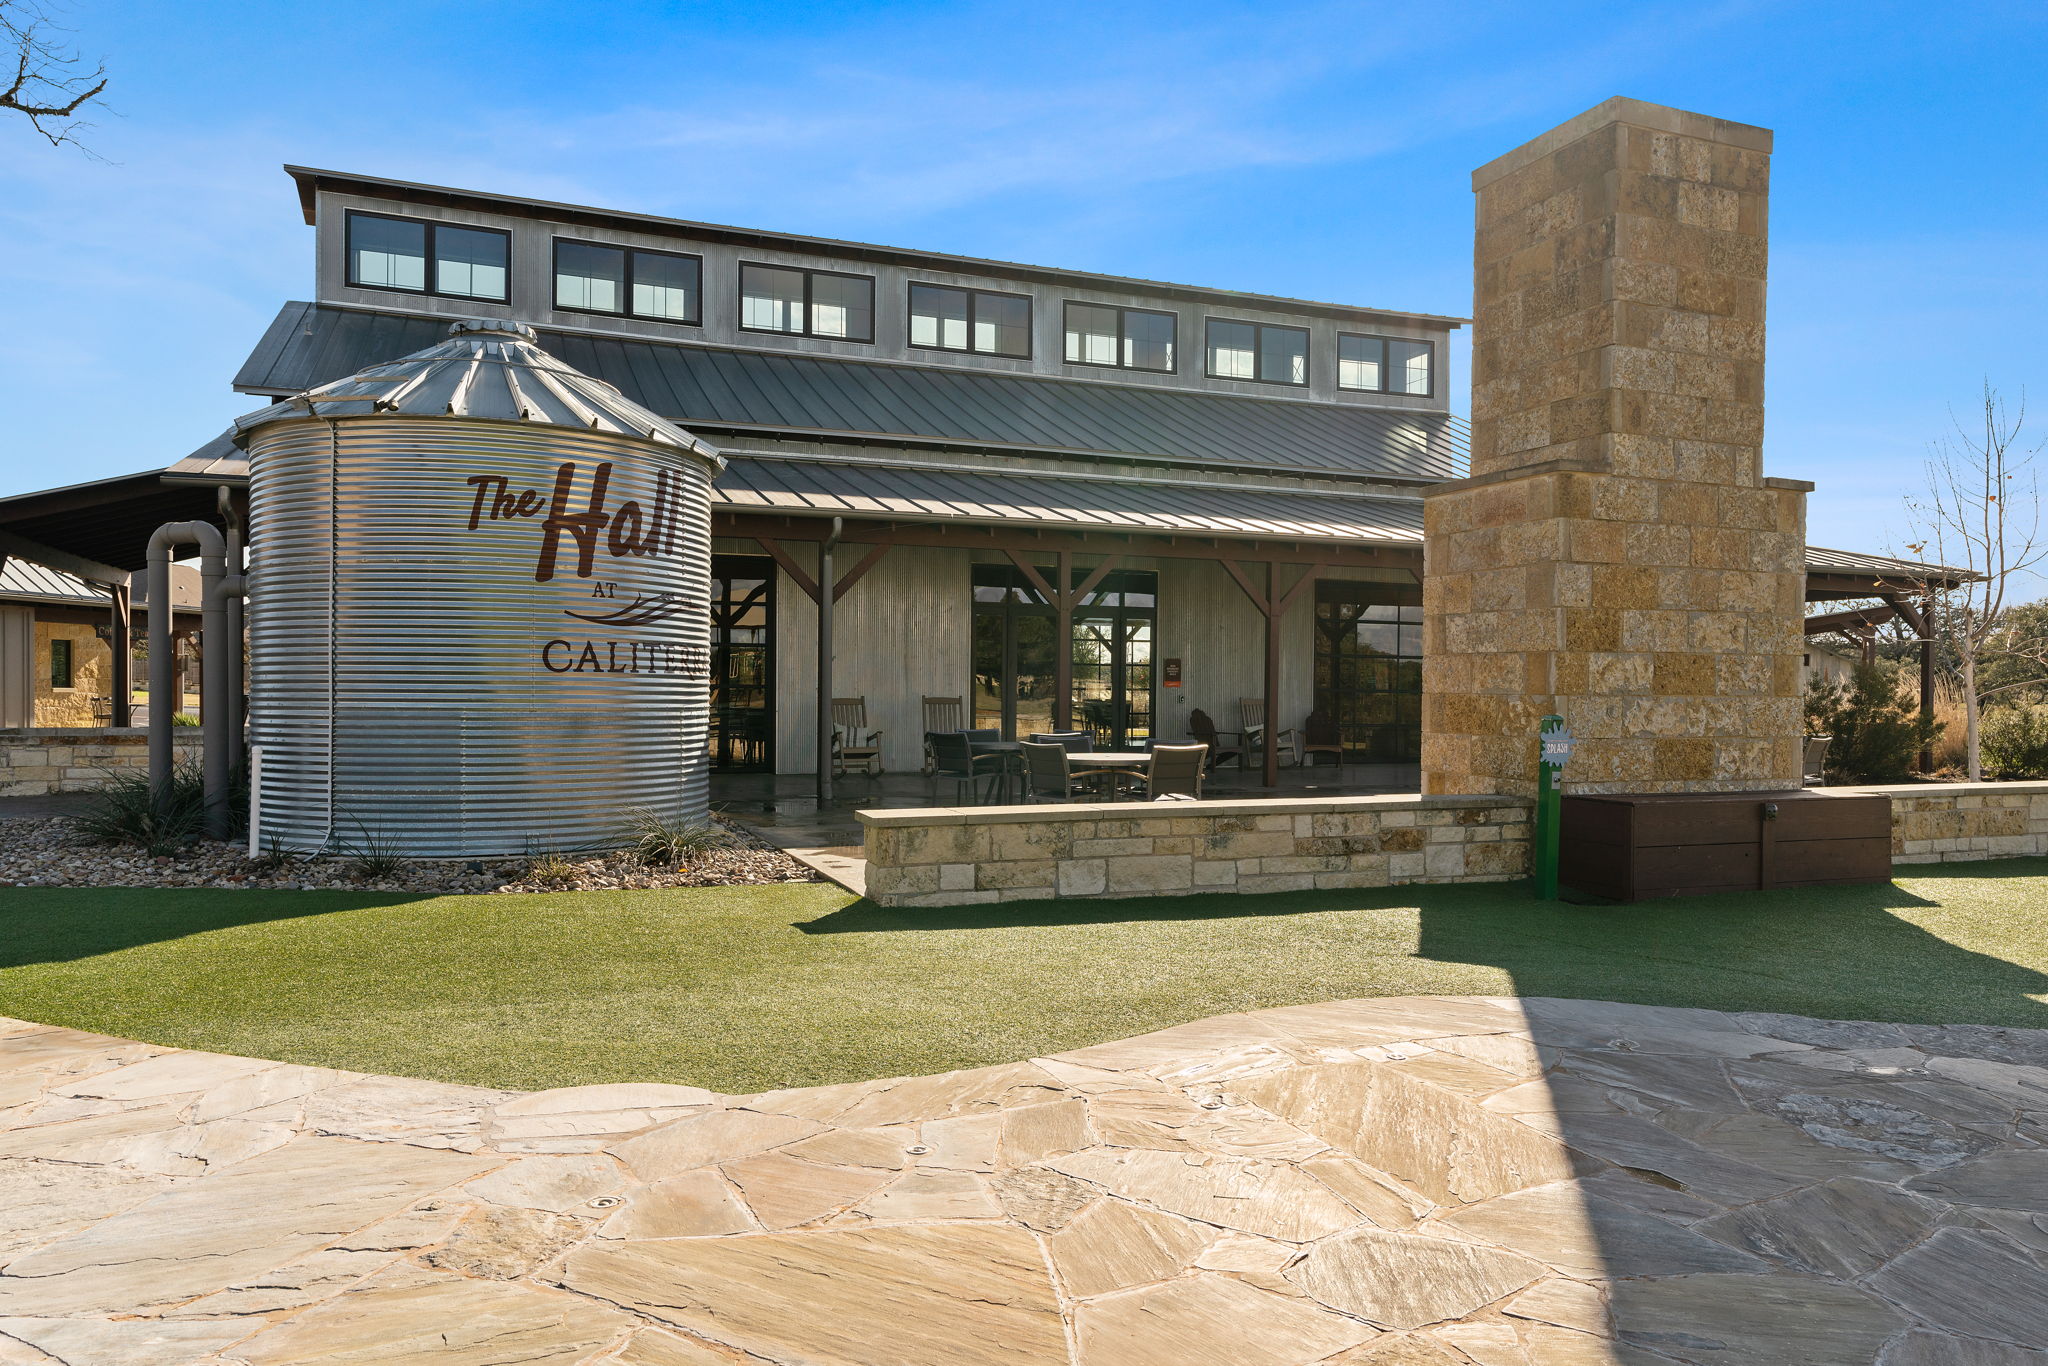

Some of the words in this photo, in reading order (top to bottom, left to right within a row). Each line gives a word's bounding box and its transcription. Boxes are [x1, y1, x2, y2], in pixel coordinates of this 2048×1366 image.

[467, 475, 546, 530] The
[535, 462, 682, 582] Hall
[591, 581, 618, 598] AT
[1546, 743, 1568, 754] SPLASH
